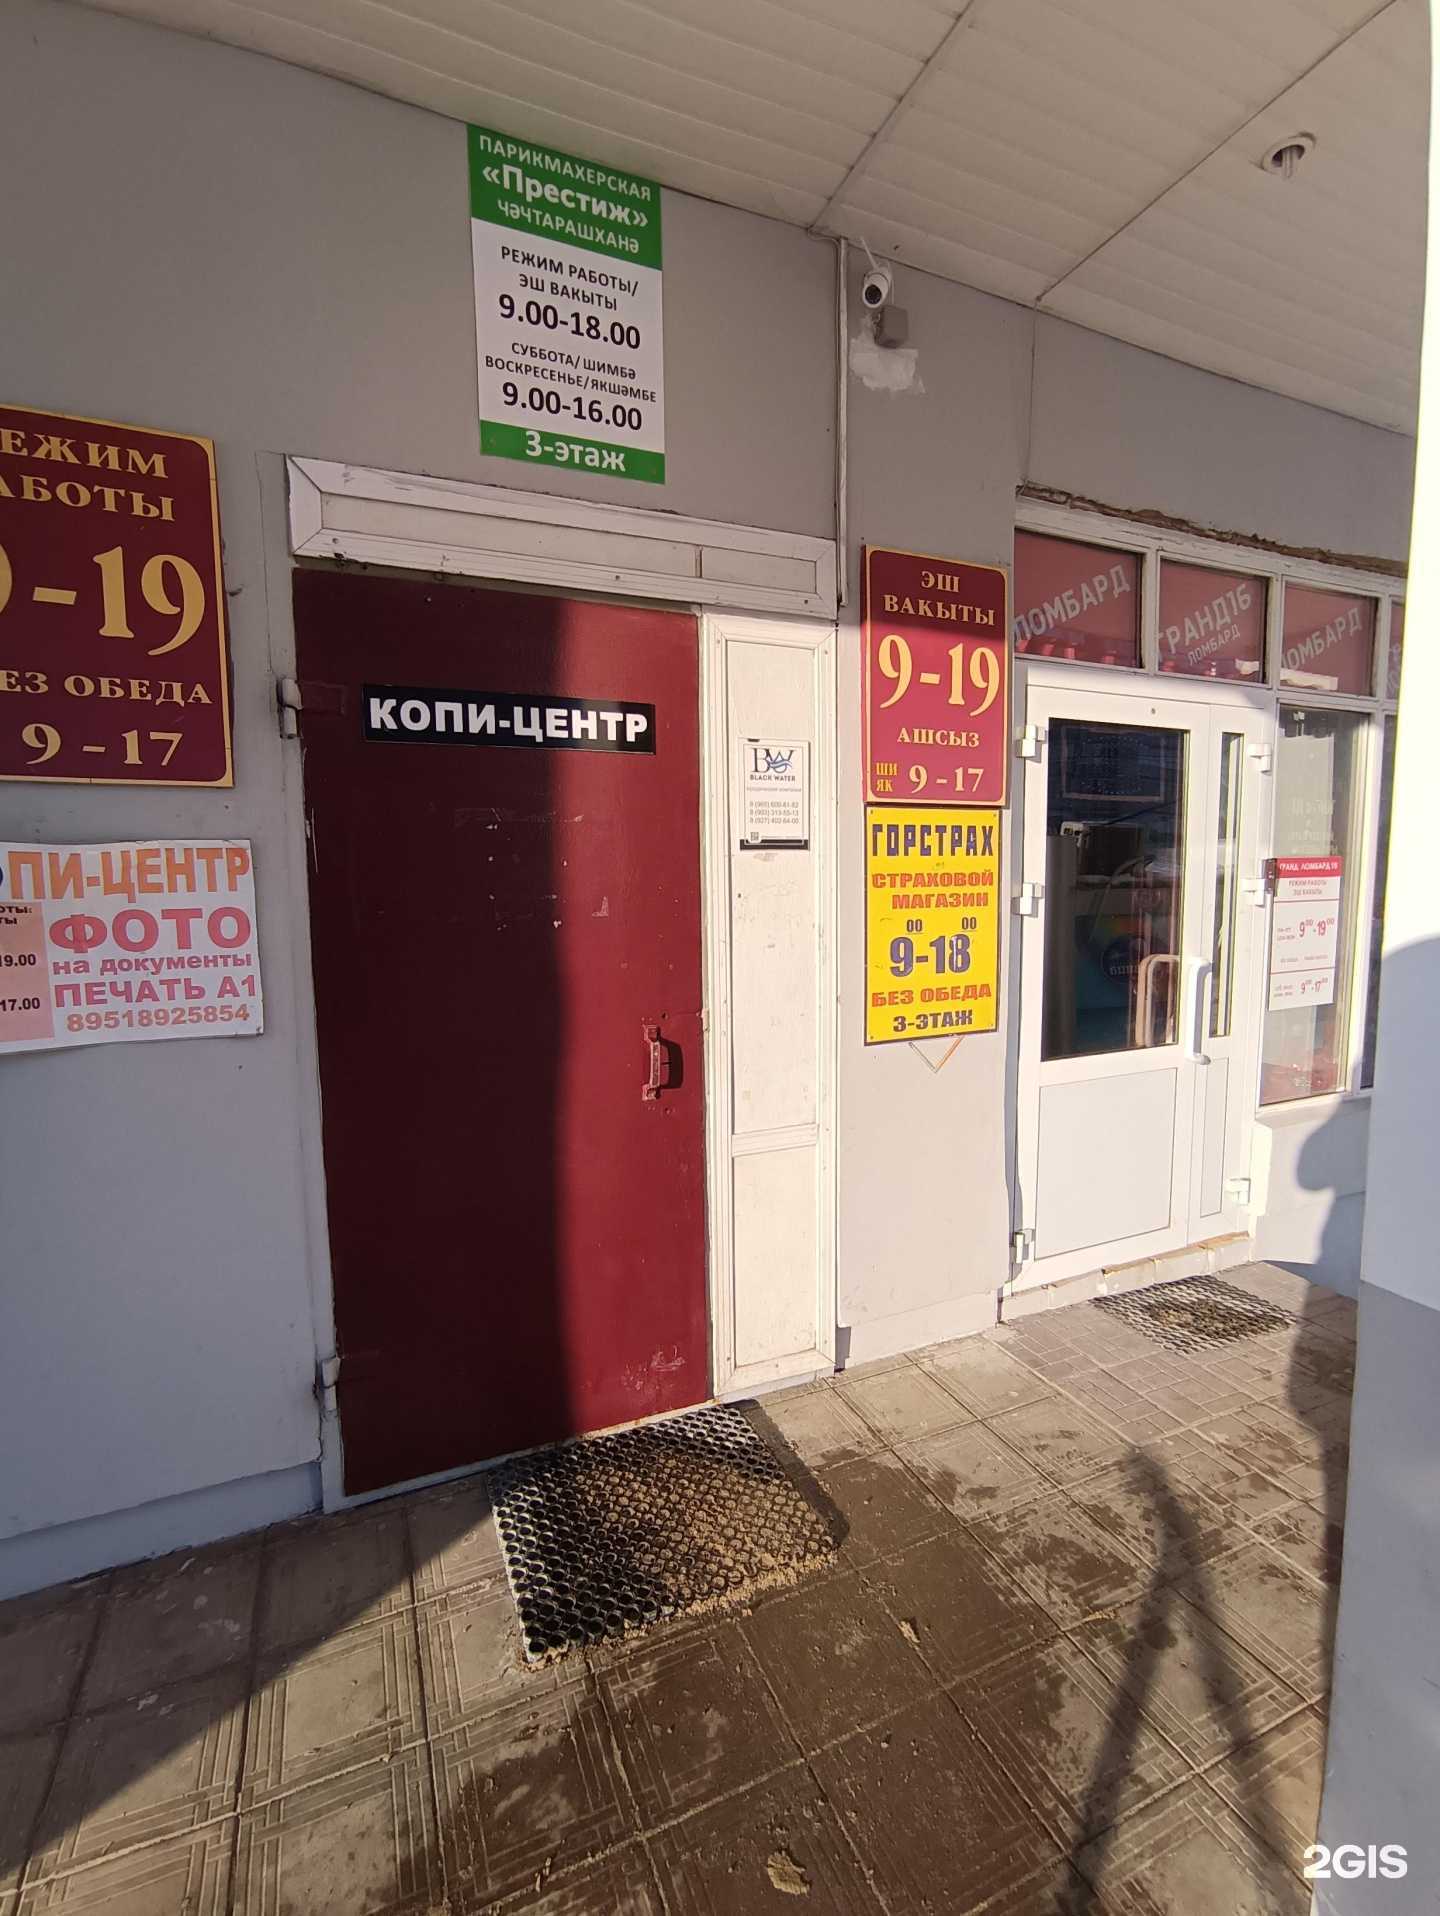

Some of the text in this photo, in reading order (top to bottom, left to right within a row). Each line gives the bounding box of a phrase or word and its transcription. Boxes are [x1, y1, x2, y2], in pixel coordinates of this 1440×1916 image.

[479, 134, 652, 202] ПАРИКМАХЕРСКАЯ
[482, 163, 649, 228] «Престиж»
[501, 246, 640, 297] РЕЖИМ РАБОТЫ/
[519, 273, 618, 312] ЭШ ВАКЫТЫ
[498, 293, 641, 350] 9.00-18.00
[502, 381, 642, 431] 9.00-16.00
[0, 428, 168, 479] ЕЖИМ
[525, 430, 627, 474] 3-этаж
[921, 570, 960, 592] ЭШ
[883, 594, 995, 626] ВАКЫТЫ
[64, 675, 212, 706] ОБЕДА
[369, 697, 649, 743] КОПИ-ЦЕНТР
[896, 727, 980, 748] АШСЫЗ
[750, 774, 796, 783] BLACK WATER
[872, 823, 994, 857] ГОРСТРАХ
[872, 869, 994, 889] СТРАХОВОЙ
[892, 892, 989, 910] МАГАЗИН
[49, 906, 251, 954] ФОТО
[53, 953, 253, 977] на документы
[54, 977, 207, 1008] ПЕЧАТЬ
[871, 983, 993, 1007] БЕЗ ОБЕДА
[66, 1003, 251, 1032] 89518925854
[893, 1009, 973, 1032] 3-ЭТАЖ
